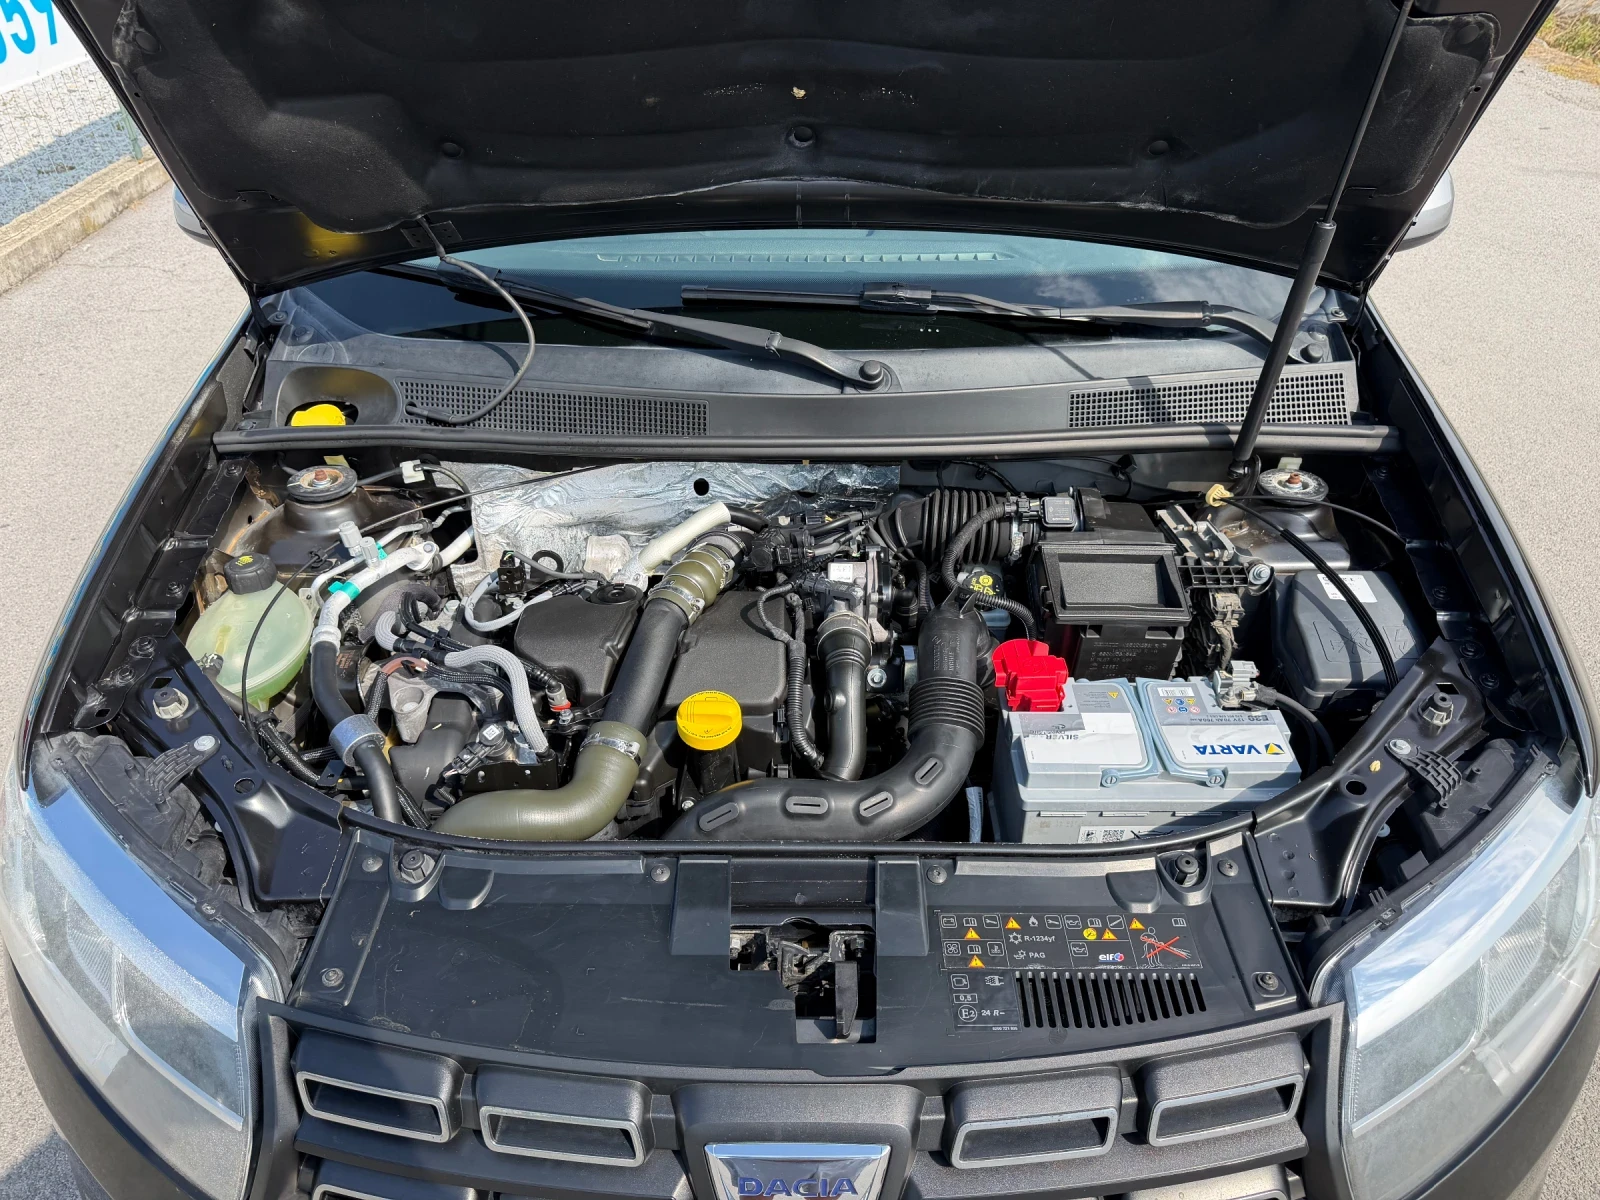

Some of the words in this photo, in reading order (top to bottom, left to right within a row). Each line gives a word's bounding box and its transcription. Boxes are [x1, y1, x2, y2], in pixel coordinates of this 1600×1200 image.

[0, 0, 58, 64] 59
[1193, 745, 1262, 756] VARTA
[1024, 935, 1056, 943] R-1234yf
[1098, 952, 1115, 961] elf
[737, 1177, 858, 1197] DACIA
